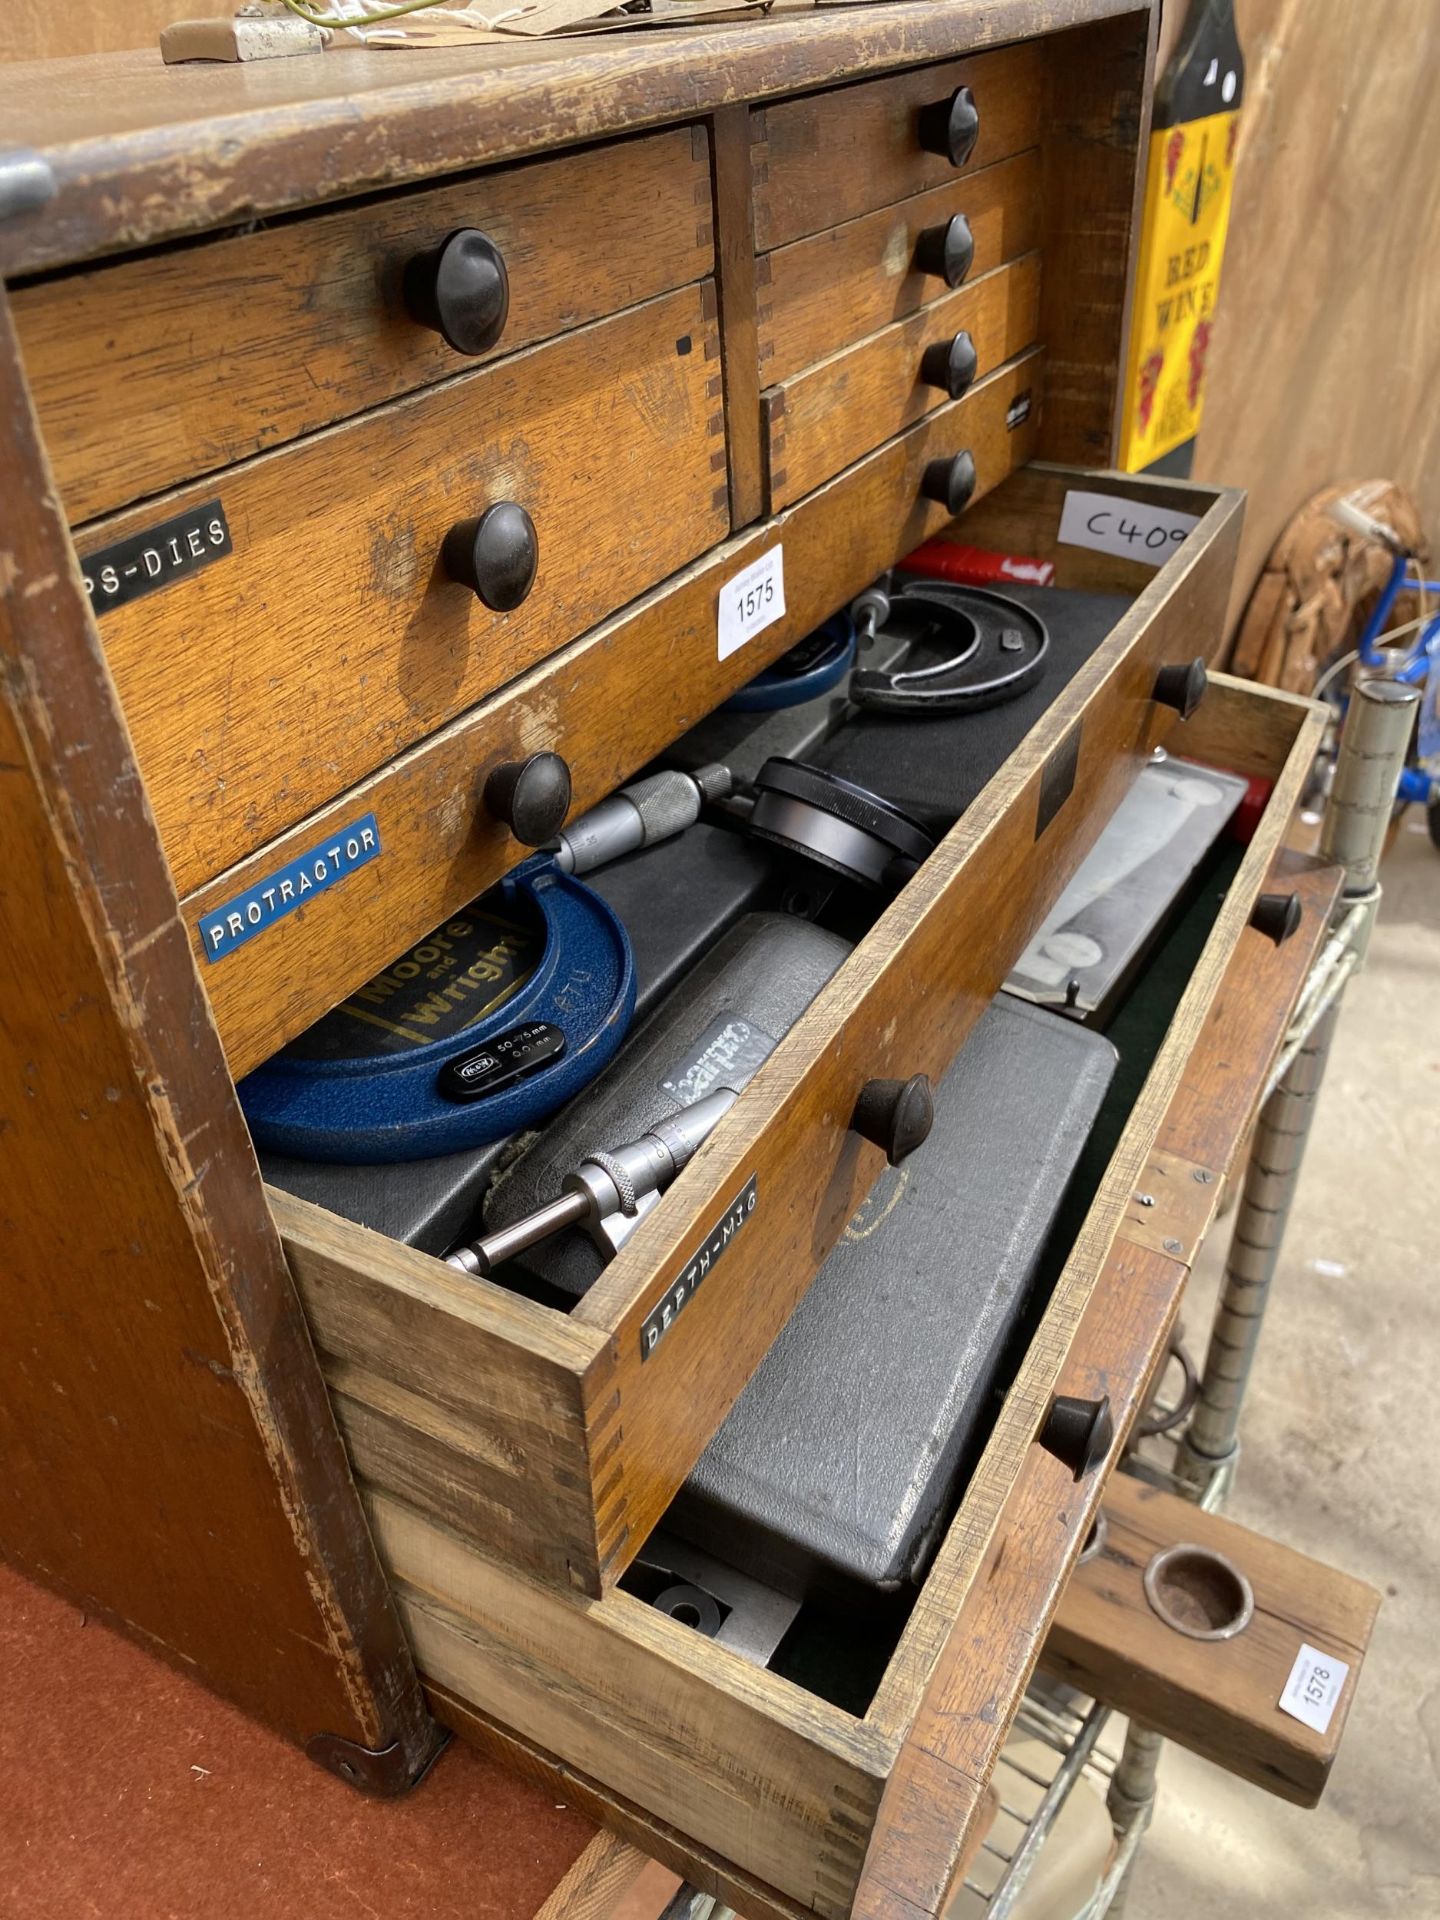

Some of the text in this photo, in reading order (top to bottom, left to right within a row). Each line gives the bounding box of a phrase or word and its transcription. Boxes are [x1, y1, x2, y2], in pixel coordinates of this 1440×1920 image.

[1165, 242, 1210, 289] RED
[1157, 281, 1214, 333] WINE
[737, 577, 774, 623] 1575
[209, 827, 376, 950] PROTRACTOR
[357, 921, 474, 1005] Moore
[401, 934, 529, 1025] Wright
[426, 954, 459, 980] and
[1303, 1666, 1331, 1707] 1578
